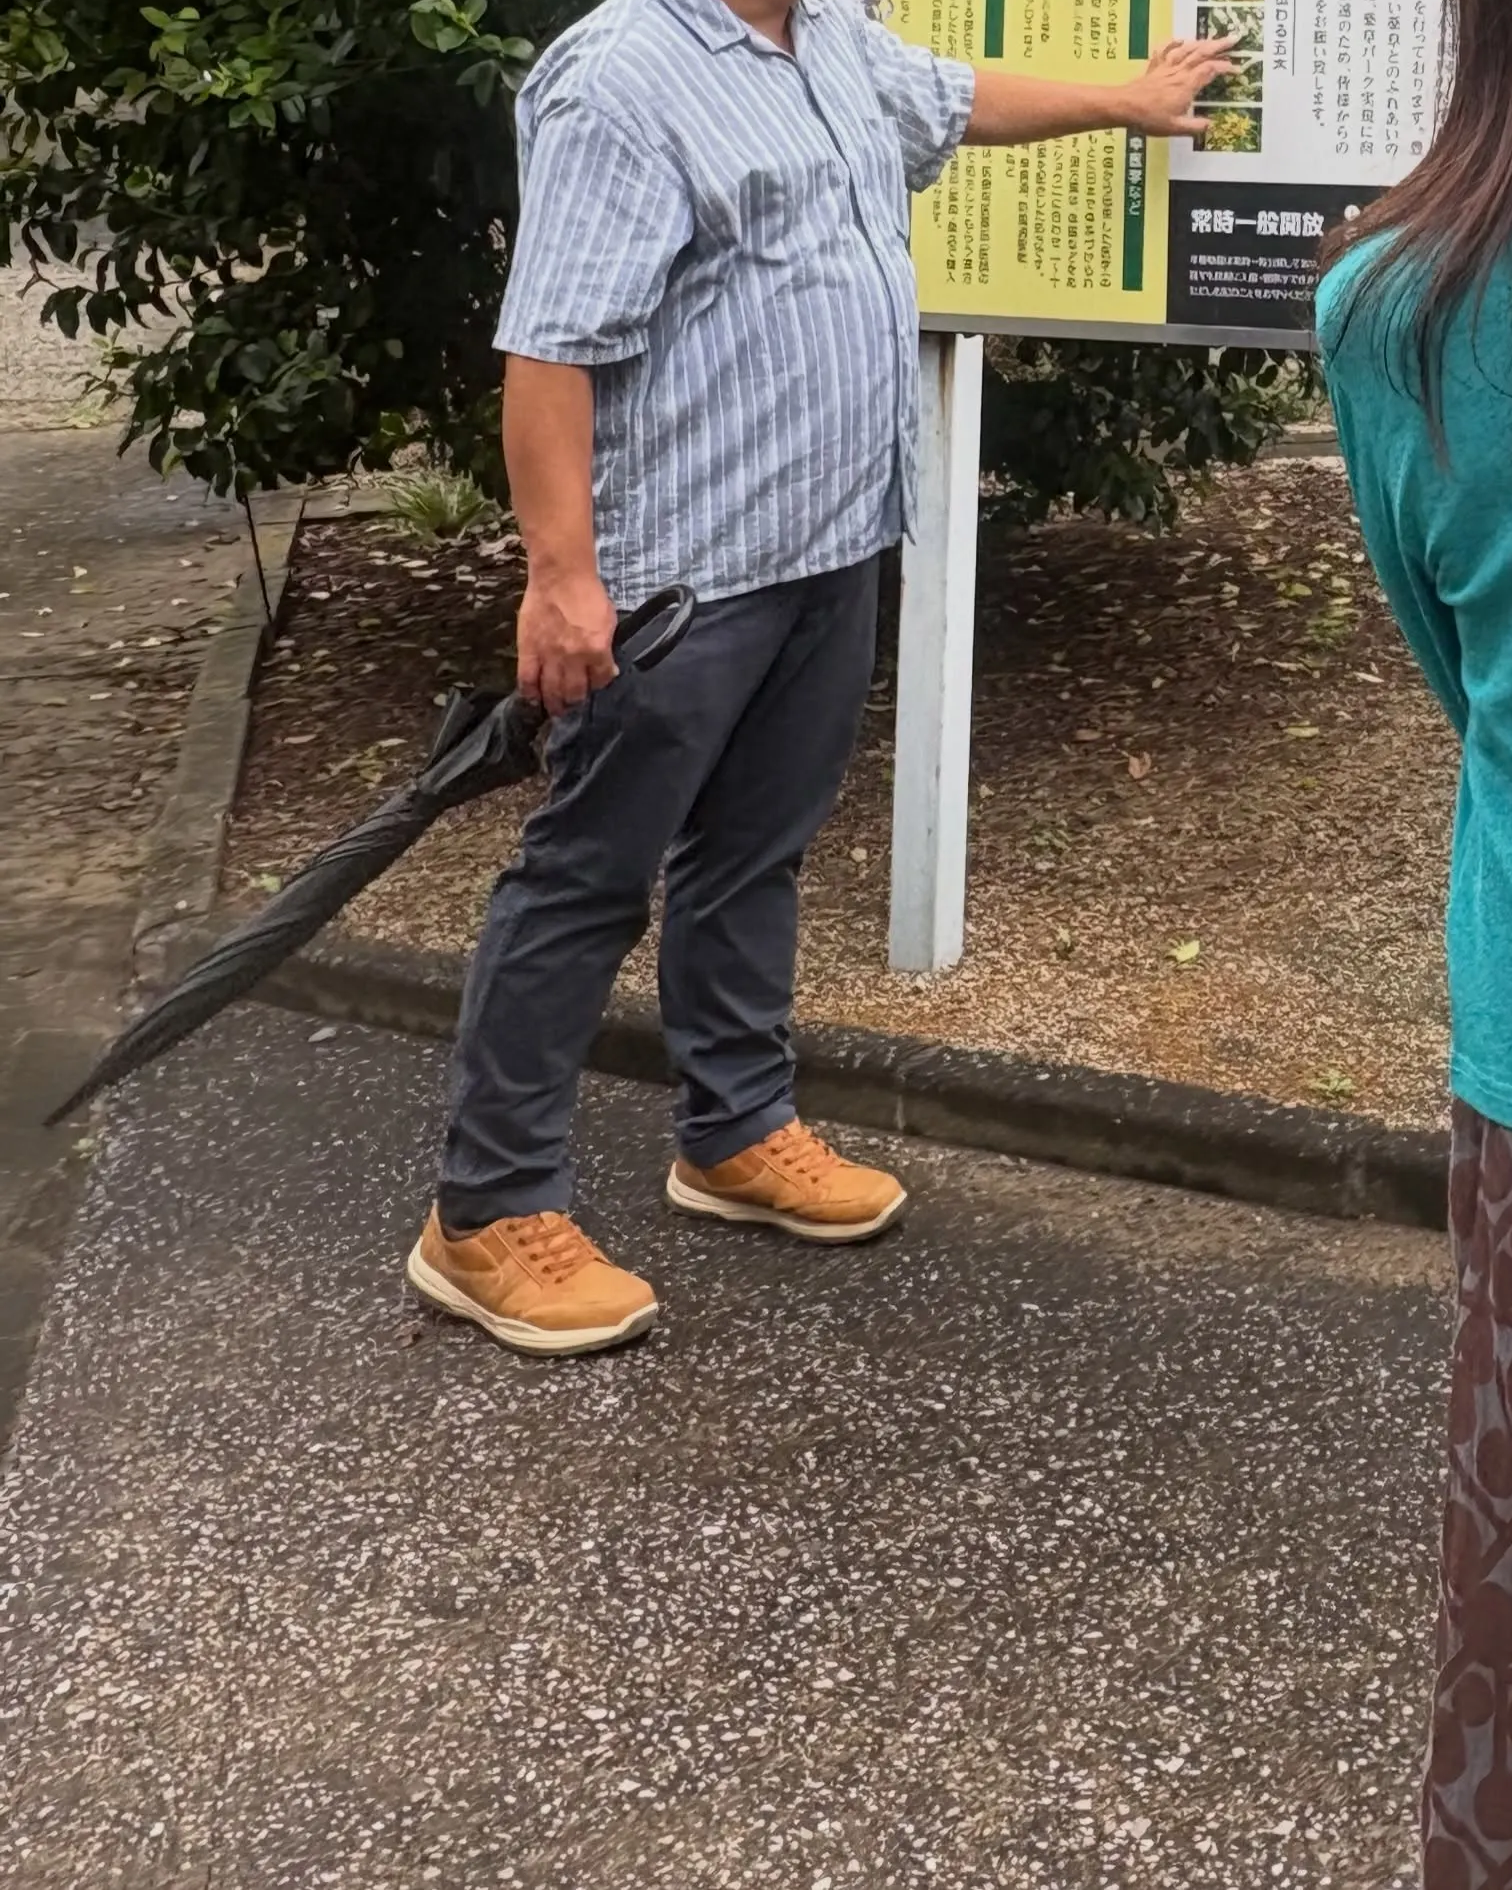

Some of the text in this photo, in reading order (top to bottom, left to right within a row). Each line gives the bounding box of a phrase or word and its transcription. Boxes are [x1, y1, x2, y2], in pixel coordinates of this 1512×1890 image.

[1190, 208, 1325, 237] 常時一般開放
